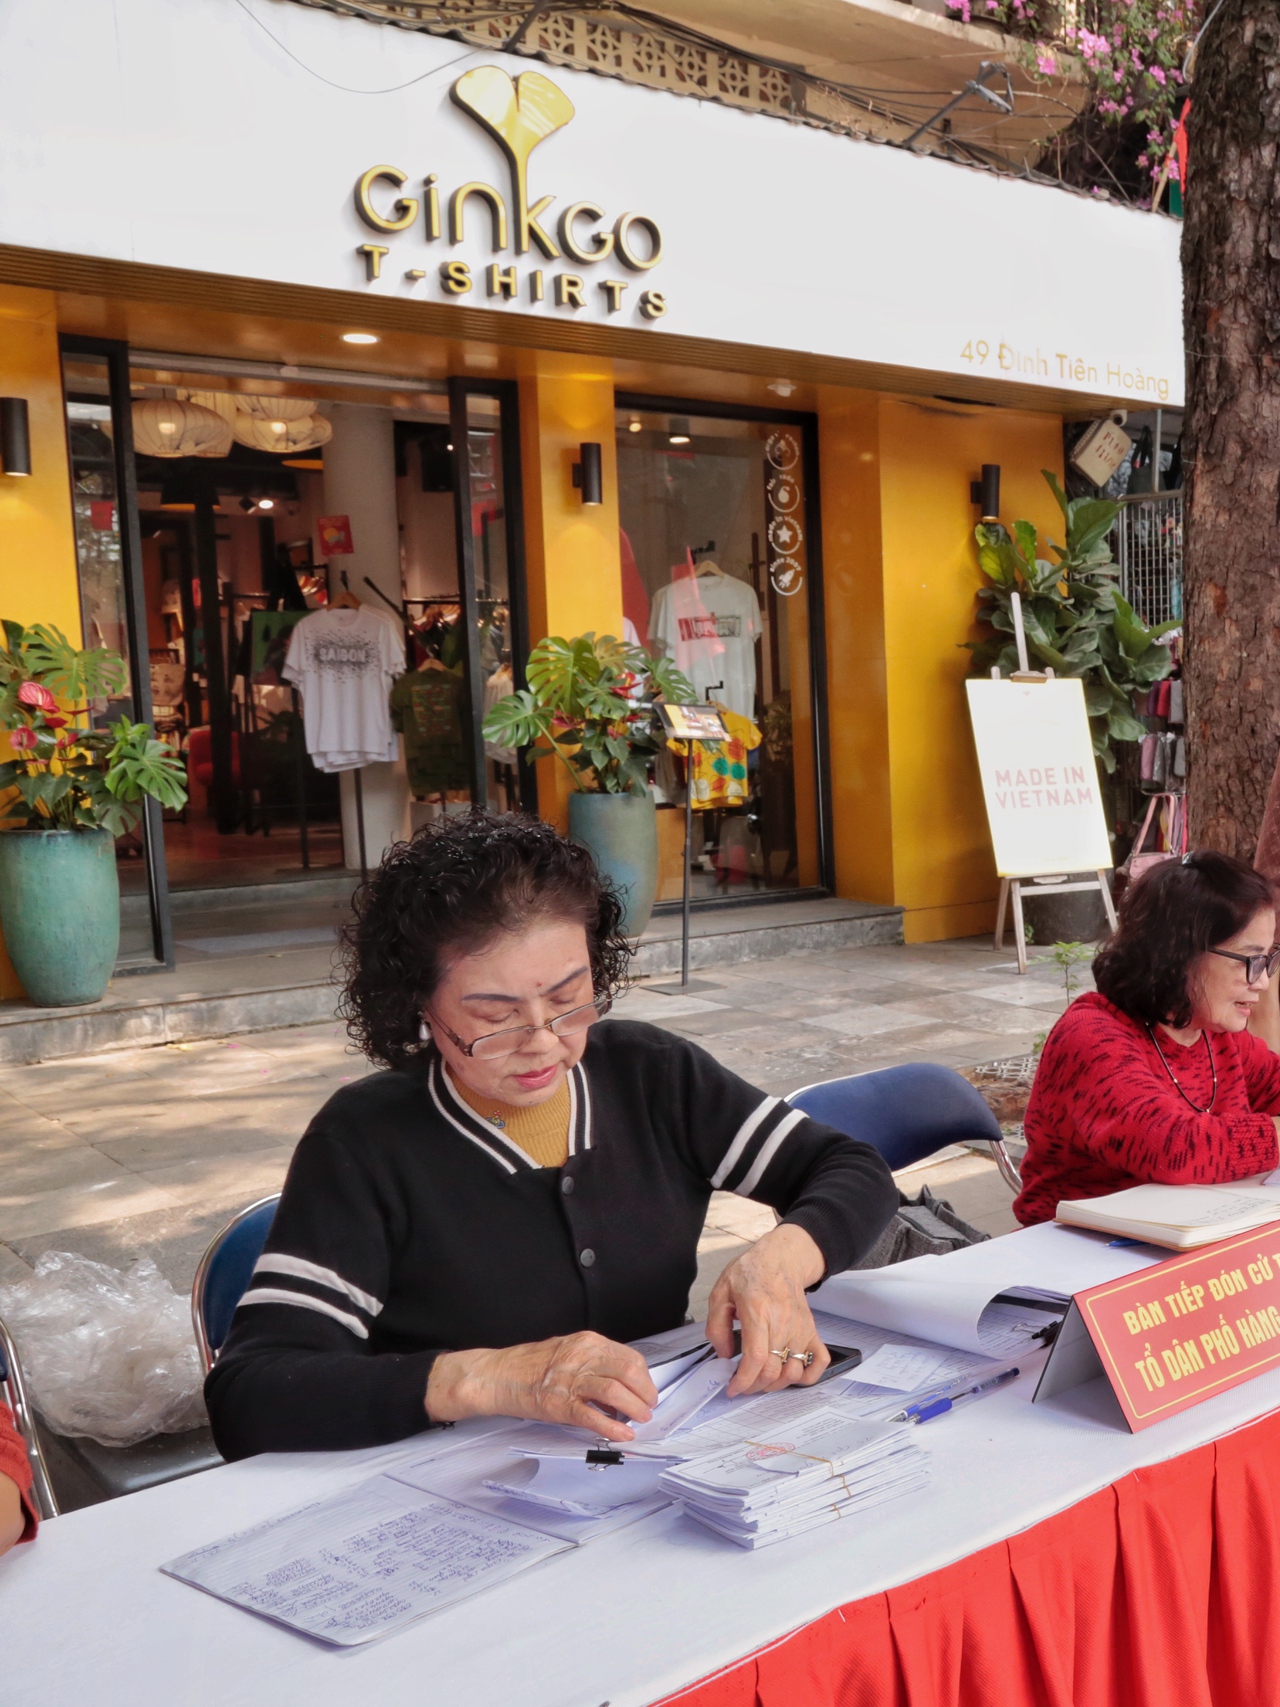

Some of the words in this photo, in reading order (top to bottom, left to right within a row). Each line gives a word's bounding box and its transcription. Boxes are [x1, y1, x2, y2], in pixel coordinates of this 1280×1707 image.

[960, 339, 990, 365] 49
[1055, 352, 1099, 384] Tiên
[1106, 362, 1170, 401] Hoàng
[767, 517, 779, 543] made
[784, 515, 803, 542] vietnam
[769, 557, 785, 573] since
[994, 767, 1058, 788] MADE
[1063, 766, 1086, 784] IN
[995, 787, 1094, 809] VIETNAM
[1122, 1302, 1167, 1335] BÀN
[1164, 1280, 1206, 1318] TIẾP
[1206, 1268, 1248, 1302] ĐÓN
[1247, 1252, 1275, 1285] CỬ
[1134, 1342, 1166, 1392] TỔ
[1161, 1339, 1206, 1382] DÂN
[1199, 1313, 1241, 1365] PHỐ
